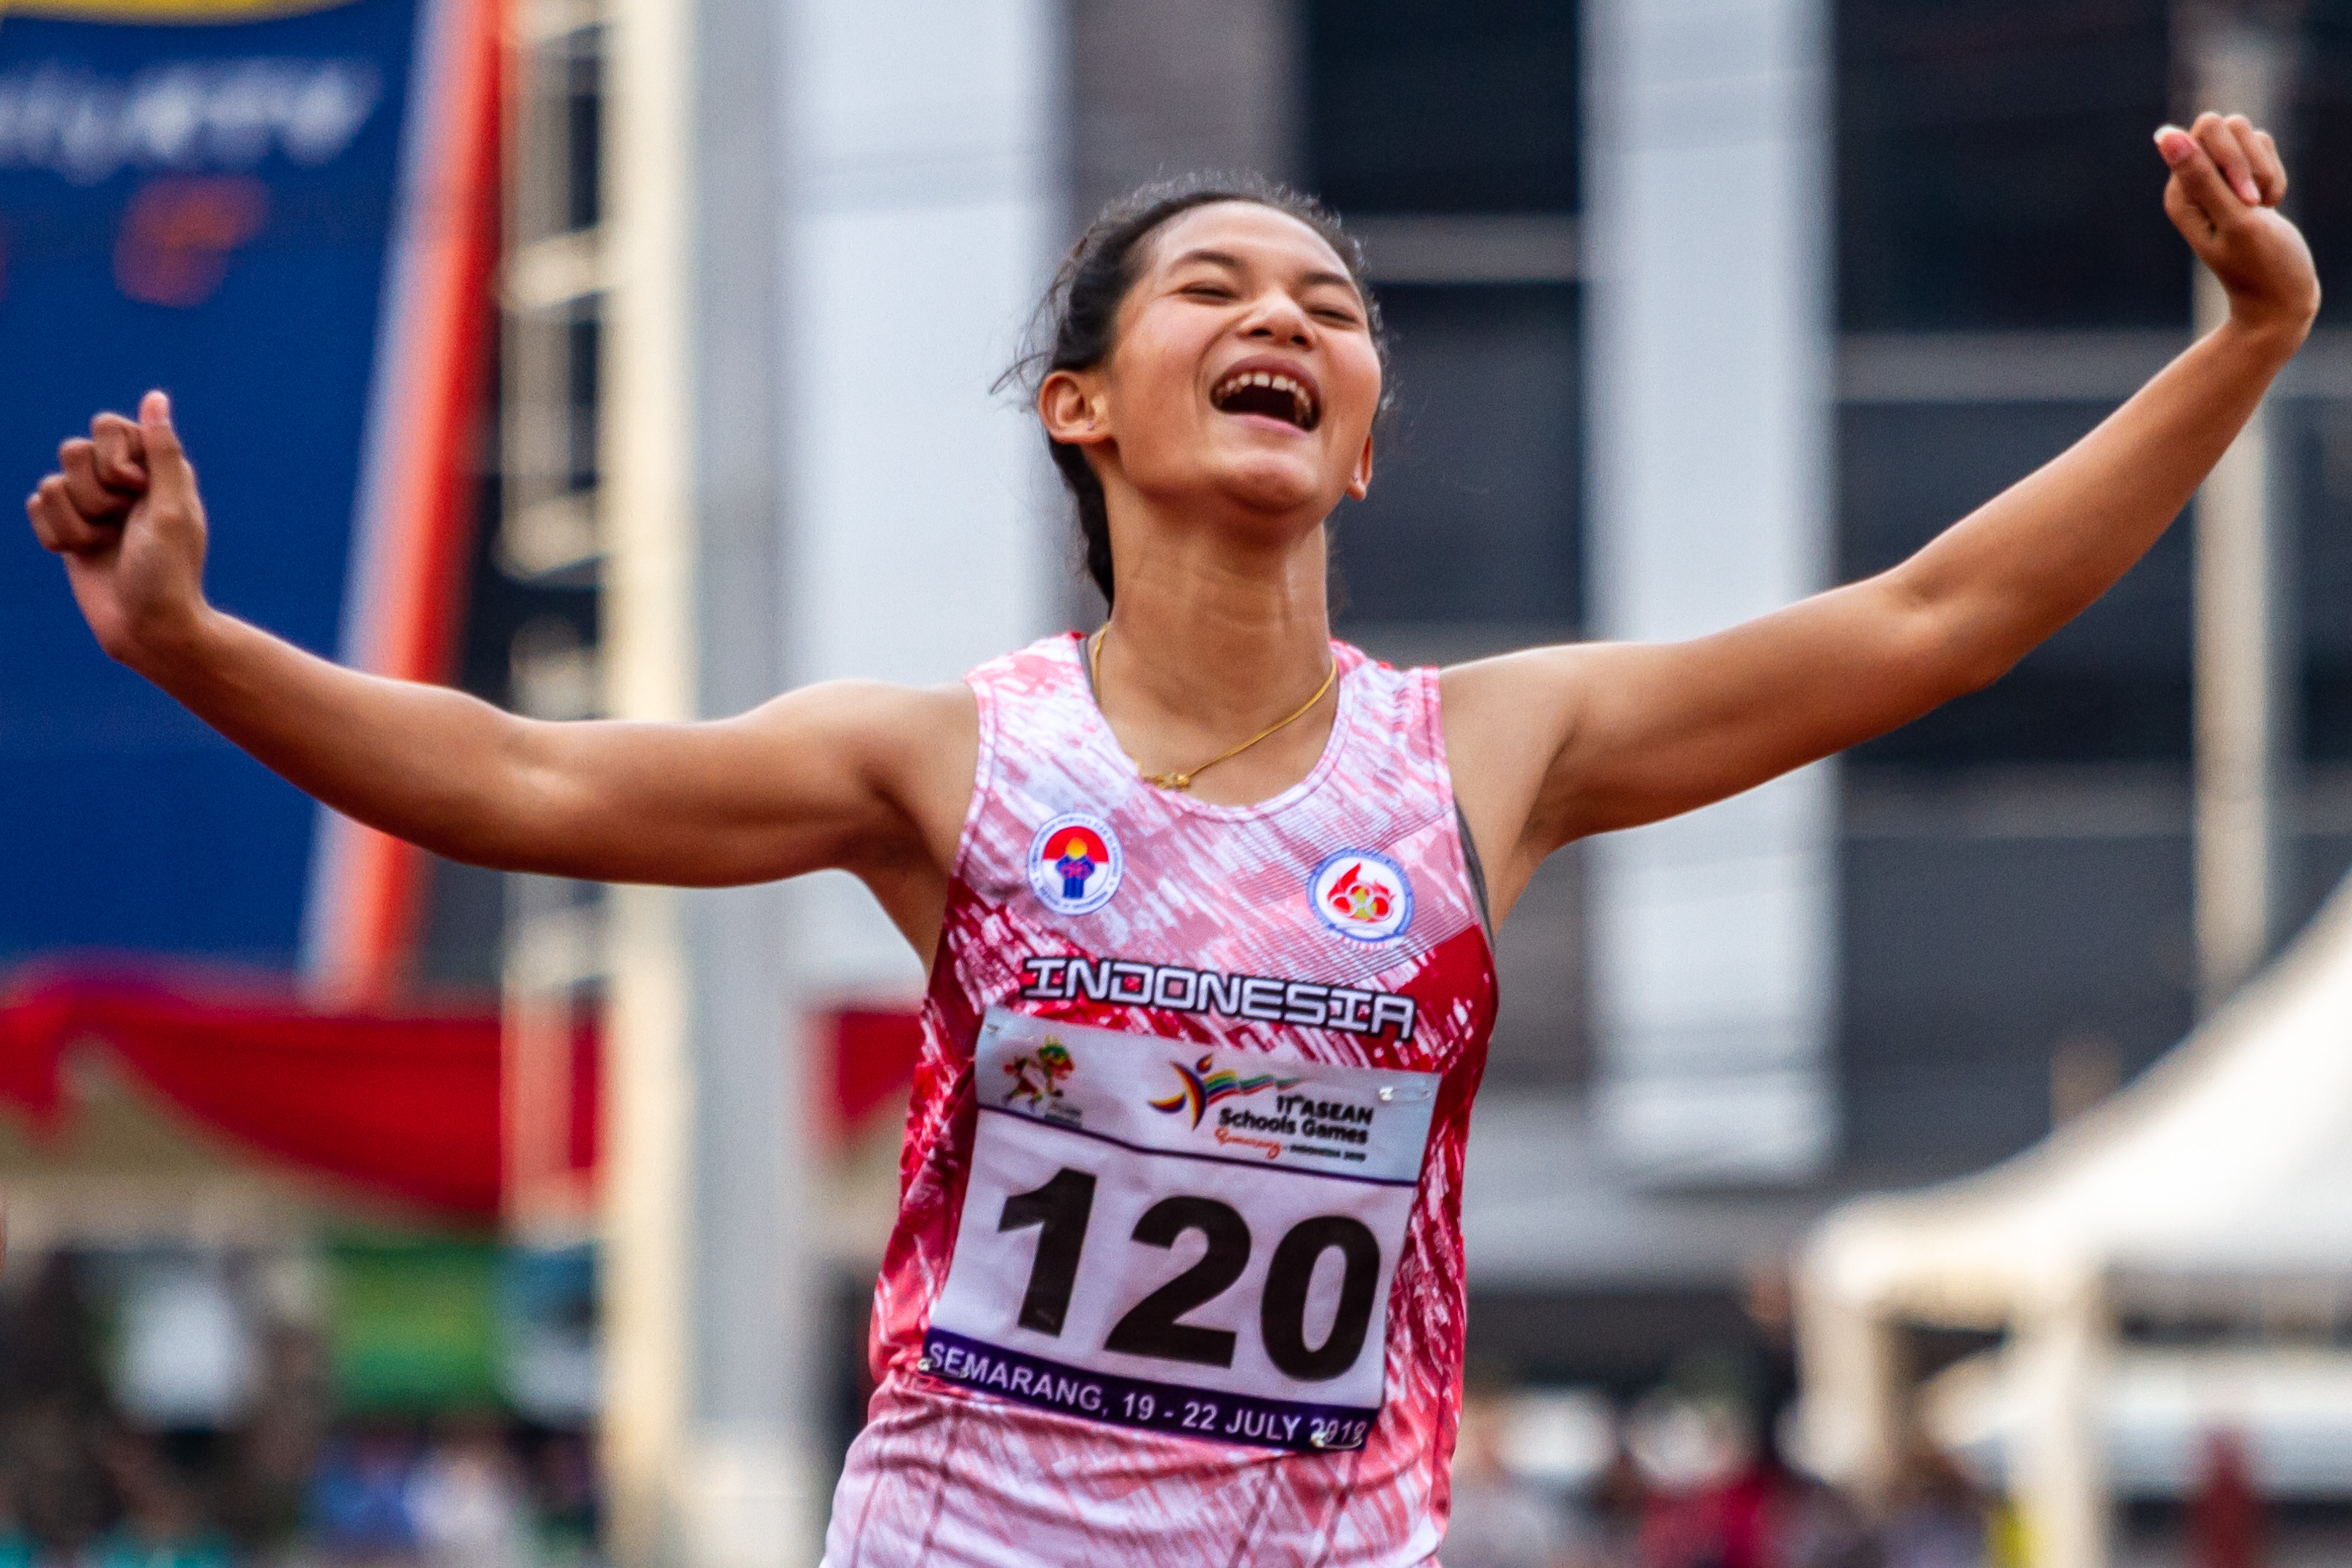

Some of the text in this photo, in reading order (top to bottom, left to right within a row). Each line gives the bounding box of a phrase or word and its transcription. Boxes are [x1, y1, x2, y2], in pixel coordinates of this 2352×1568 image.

[1024, 957, 1416, 1040] INDONESIA
[1218, 1107, 1297, 1135] Schools
[1301, 1118, 1368, 1145] Games
[1300, 1100, 1374, 1125] ASEAN
[996, 1167, 1381, 1382] 120
[928, 1342, 1109, 1418] SEMARANG,
[1123, 1392, 1156, 1421] 19
[1181, 1401, 1218, 1431] 22
[1225, 1408, 1302, 1442] JULY
